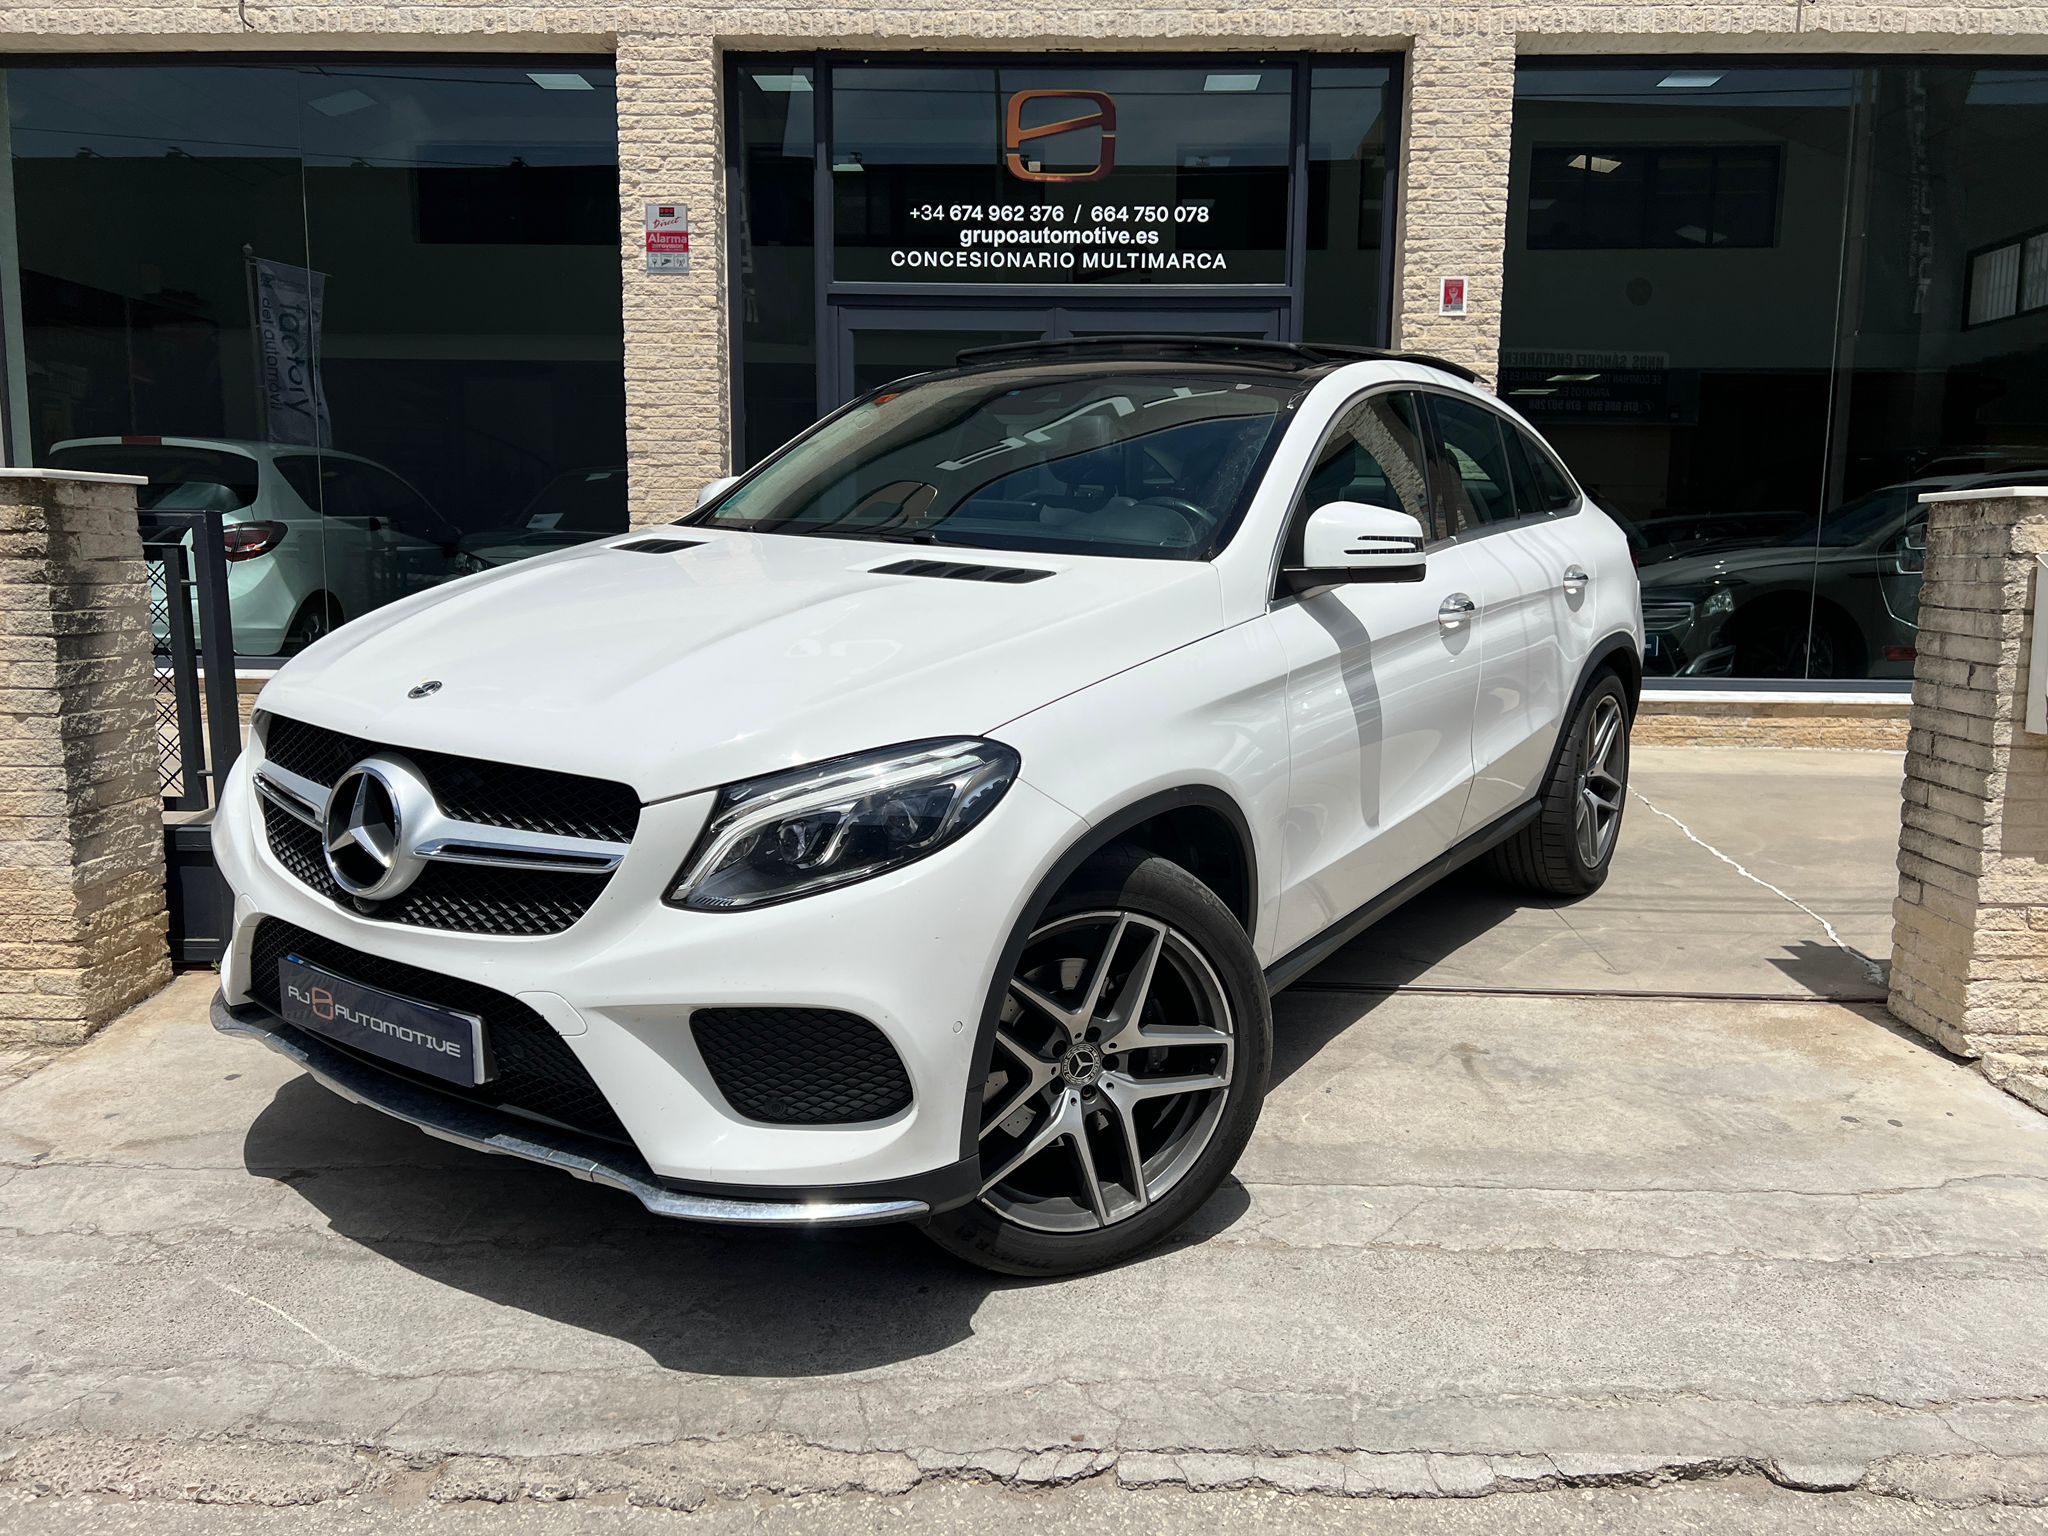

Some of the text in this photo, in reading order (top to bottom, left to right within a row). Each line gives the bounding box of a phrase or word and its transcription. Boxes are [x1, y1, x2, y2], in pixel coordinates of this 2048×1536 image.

[909, 203, 1210, 223] +34 674 962 376 / 664 750 078
[648, 232, 688, 243] Alarma
[959, 226, 1160, 248] grupoautomotive.es
[890, 250, 1227, 270] CONCESIONARIO MULTIMARCA
[262, 297, 273, 323] del
[263, 329, 283, 411] automóvil
[279, 303, 311, 417] factory
[288, 985, 461, 1059] AJ AUTOMOTIVE
